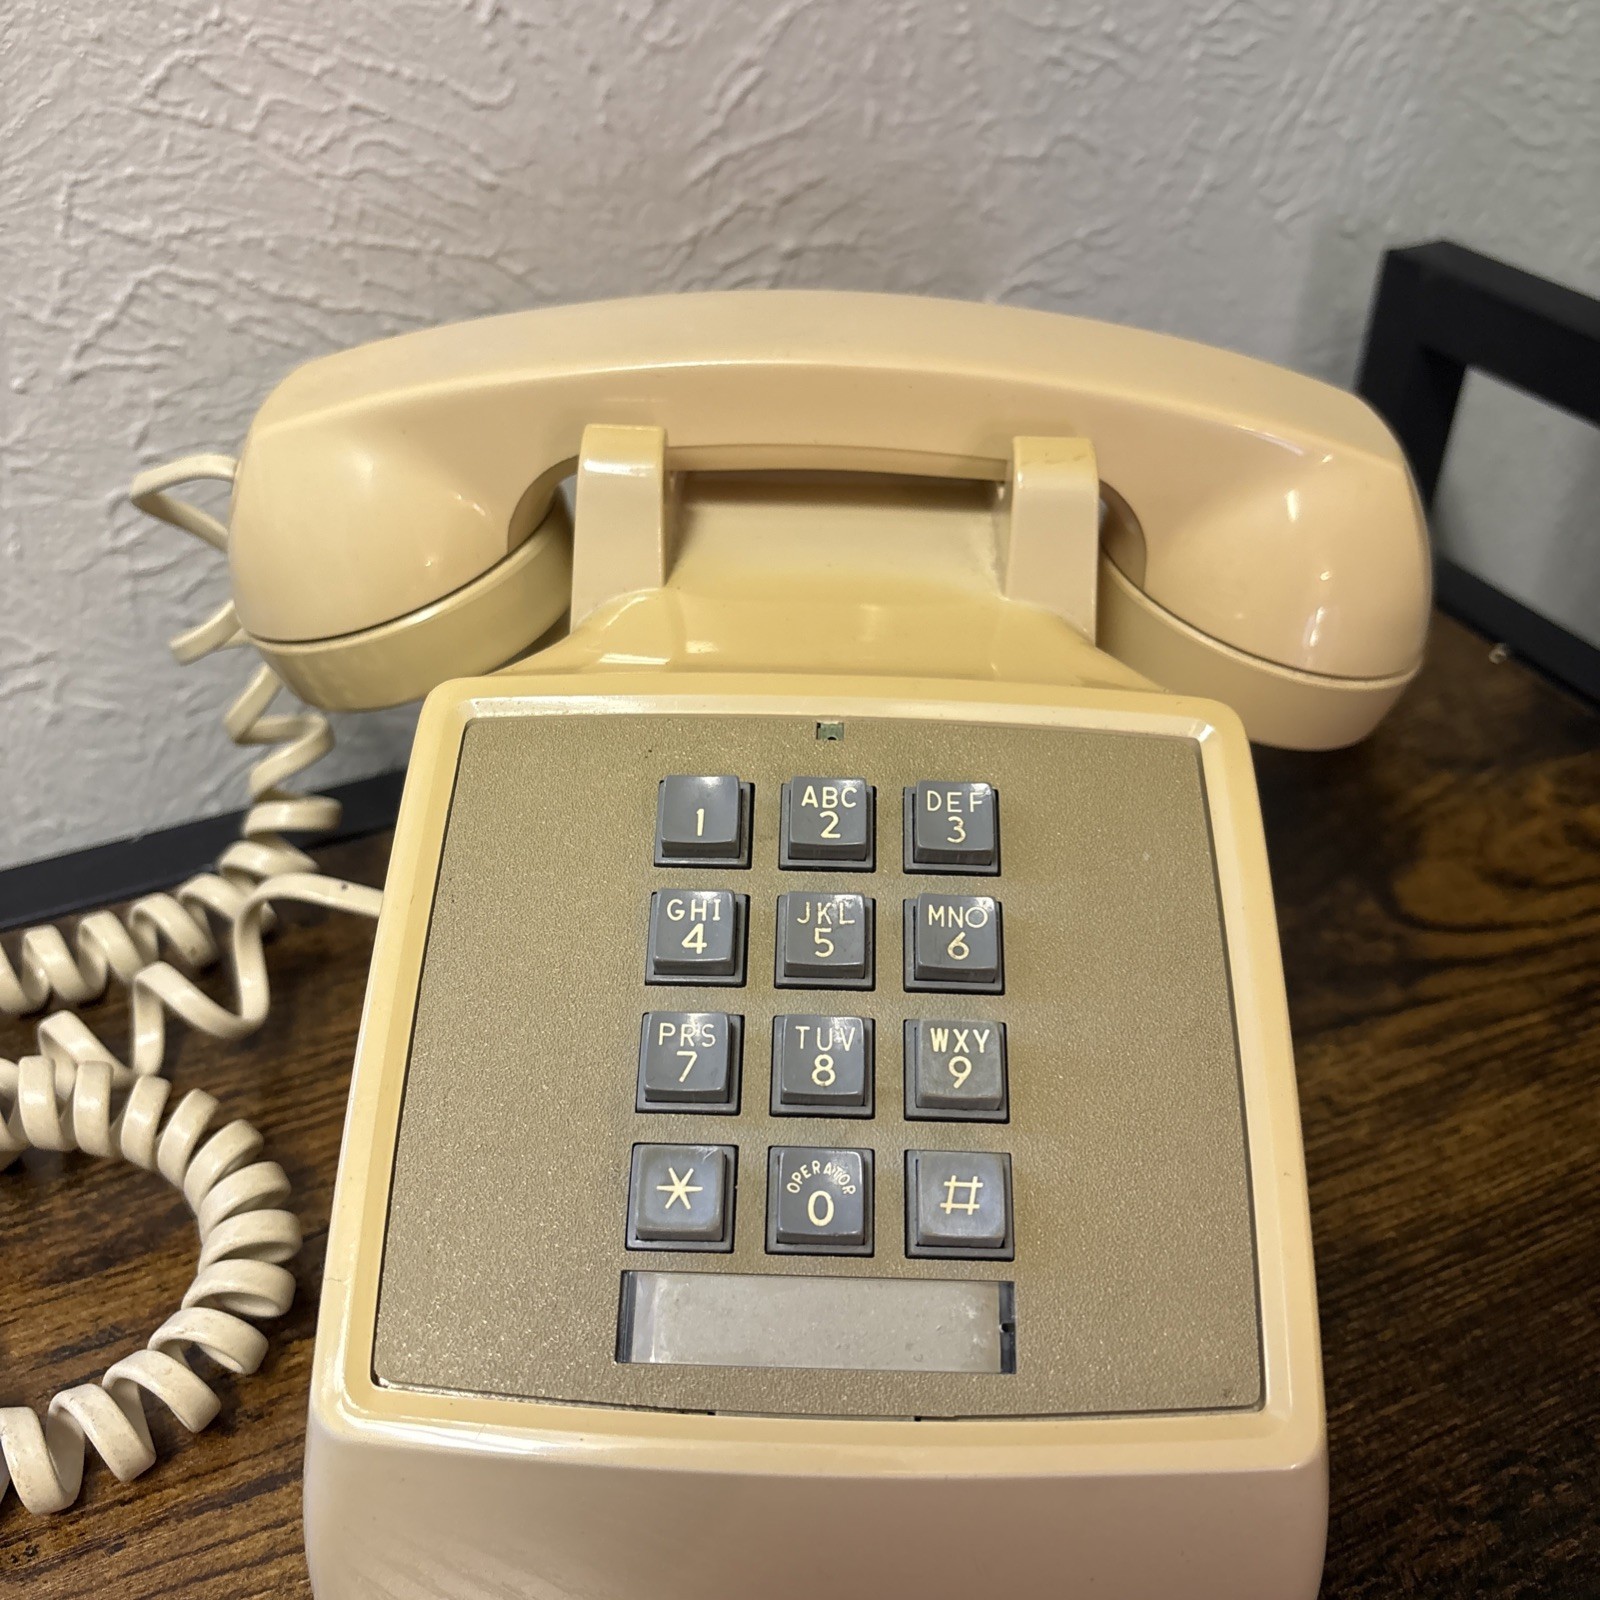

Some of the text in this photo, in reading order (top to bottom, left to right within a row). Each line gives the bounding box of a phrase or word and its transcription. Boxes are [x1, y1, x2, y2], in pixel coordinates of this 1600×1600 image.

[801, 785, 858, 809] ABC
[926, 790, 983, 813] DEF
[695, 808, 705, 837] 1
[819, 810, 841, 839] 2
[946, 816, 967, 843] 3
[666, 898, 721, 921] GHI
[796, 901, 855, 925] JKL
[928, 904, 988, 929] MNO
[681, 923, 708, 954] 4
[814, 927, 835, 958] 5
[947, 931, 970, 960] 6
[658, 1022, 716, 1048] PRS
[795, 1025, 856, 1052] TUV
[930, 1027, 990, 1054] WXY
[676, 1050, 698, 1083] 7
[811, 1054, 836, 1087] 8
[948, 1055, 972, 1089] 9
[786, 1160, 856, 1195] OPERATOR
[807, 1190, 835, 1227] 0
[939, 1175, 984, 1216] #
